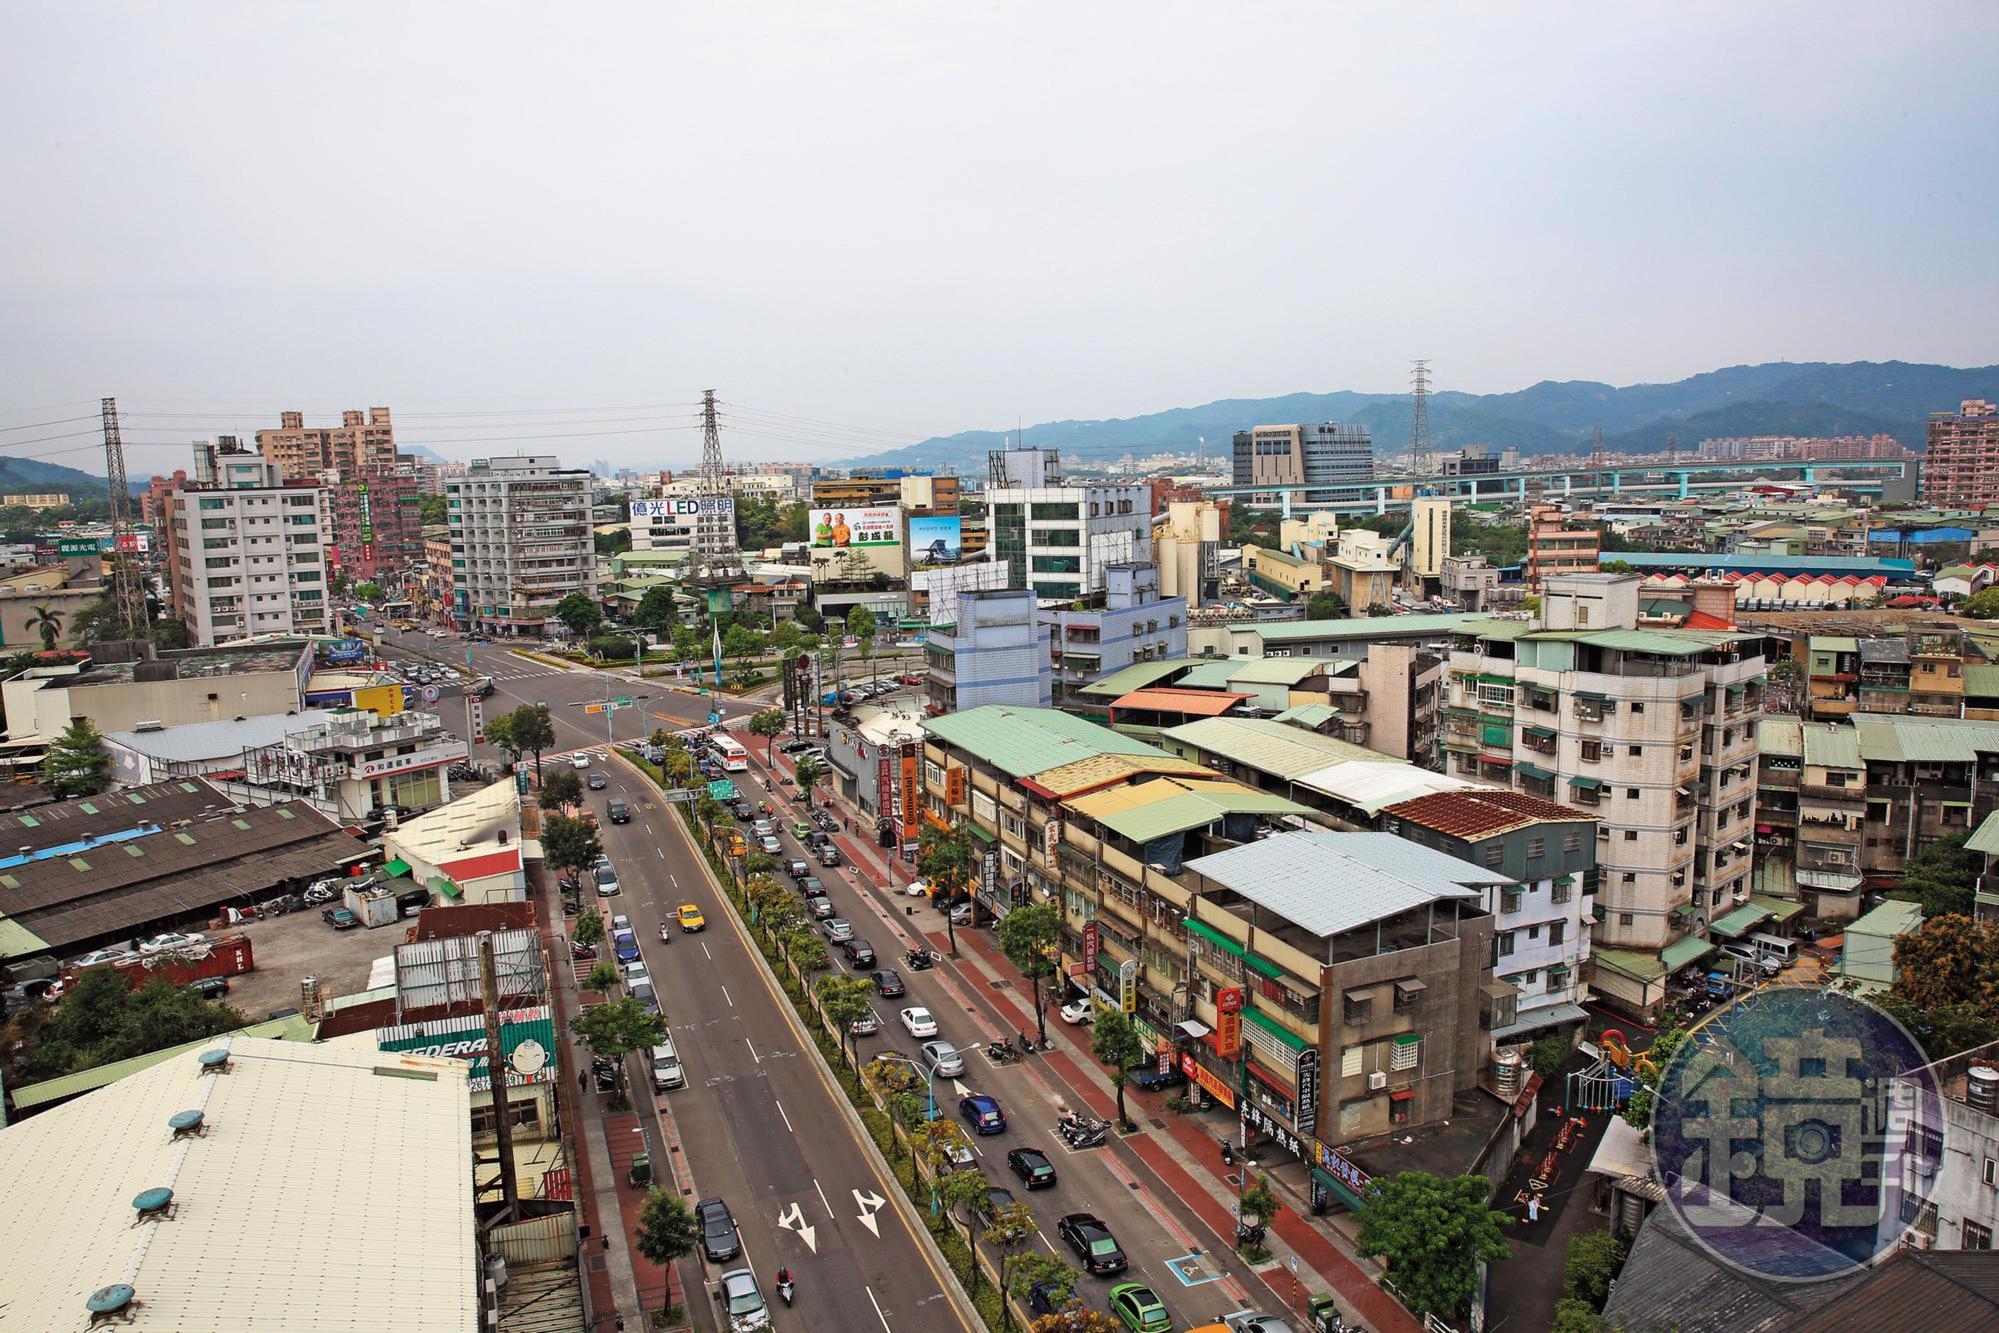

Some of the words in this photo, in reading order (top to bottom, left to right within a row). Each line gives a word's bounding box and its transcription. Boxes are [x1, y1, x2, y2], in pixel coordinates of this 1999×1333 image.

[905, 776, 915, 825] Continental
[1240, 1100, 1302, 1158] 先鋒隔熱紙
